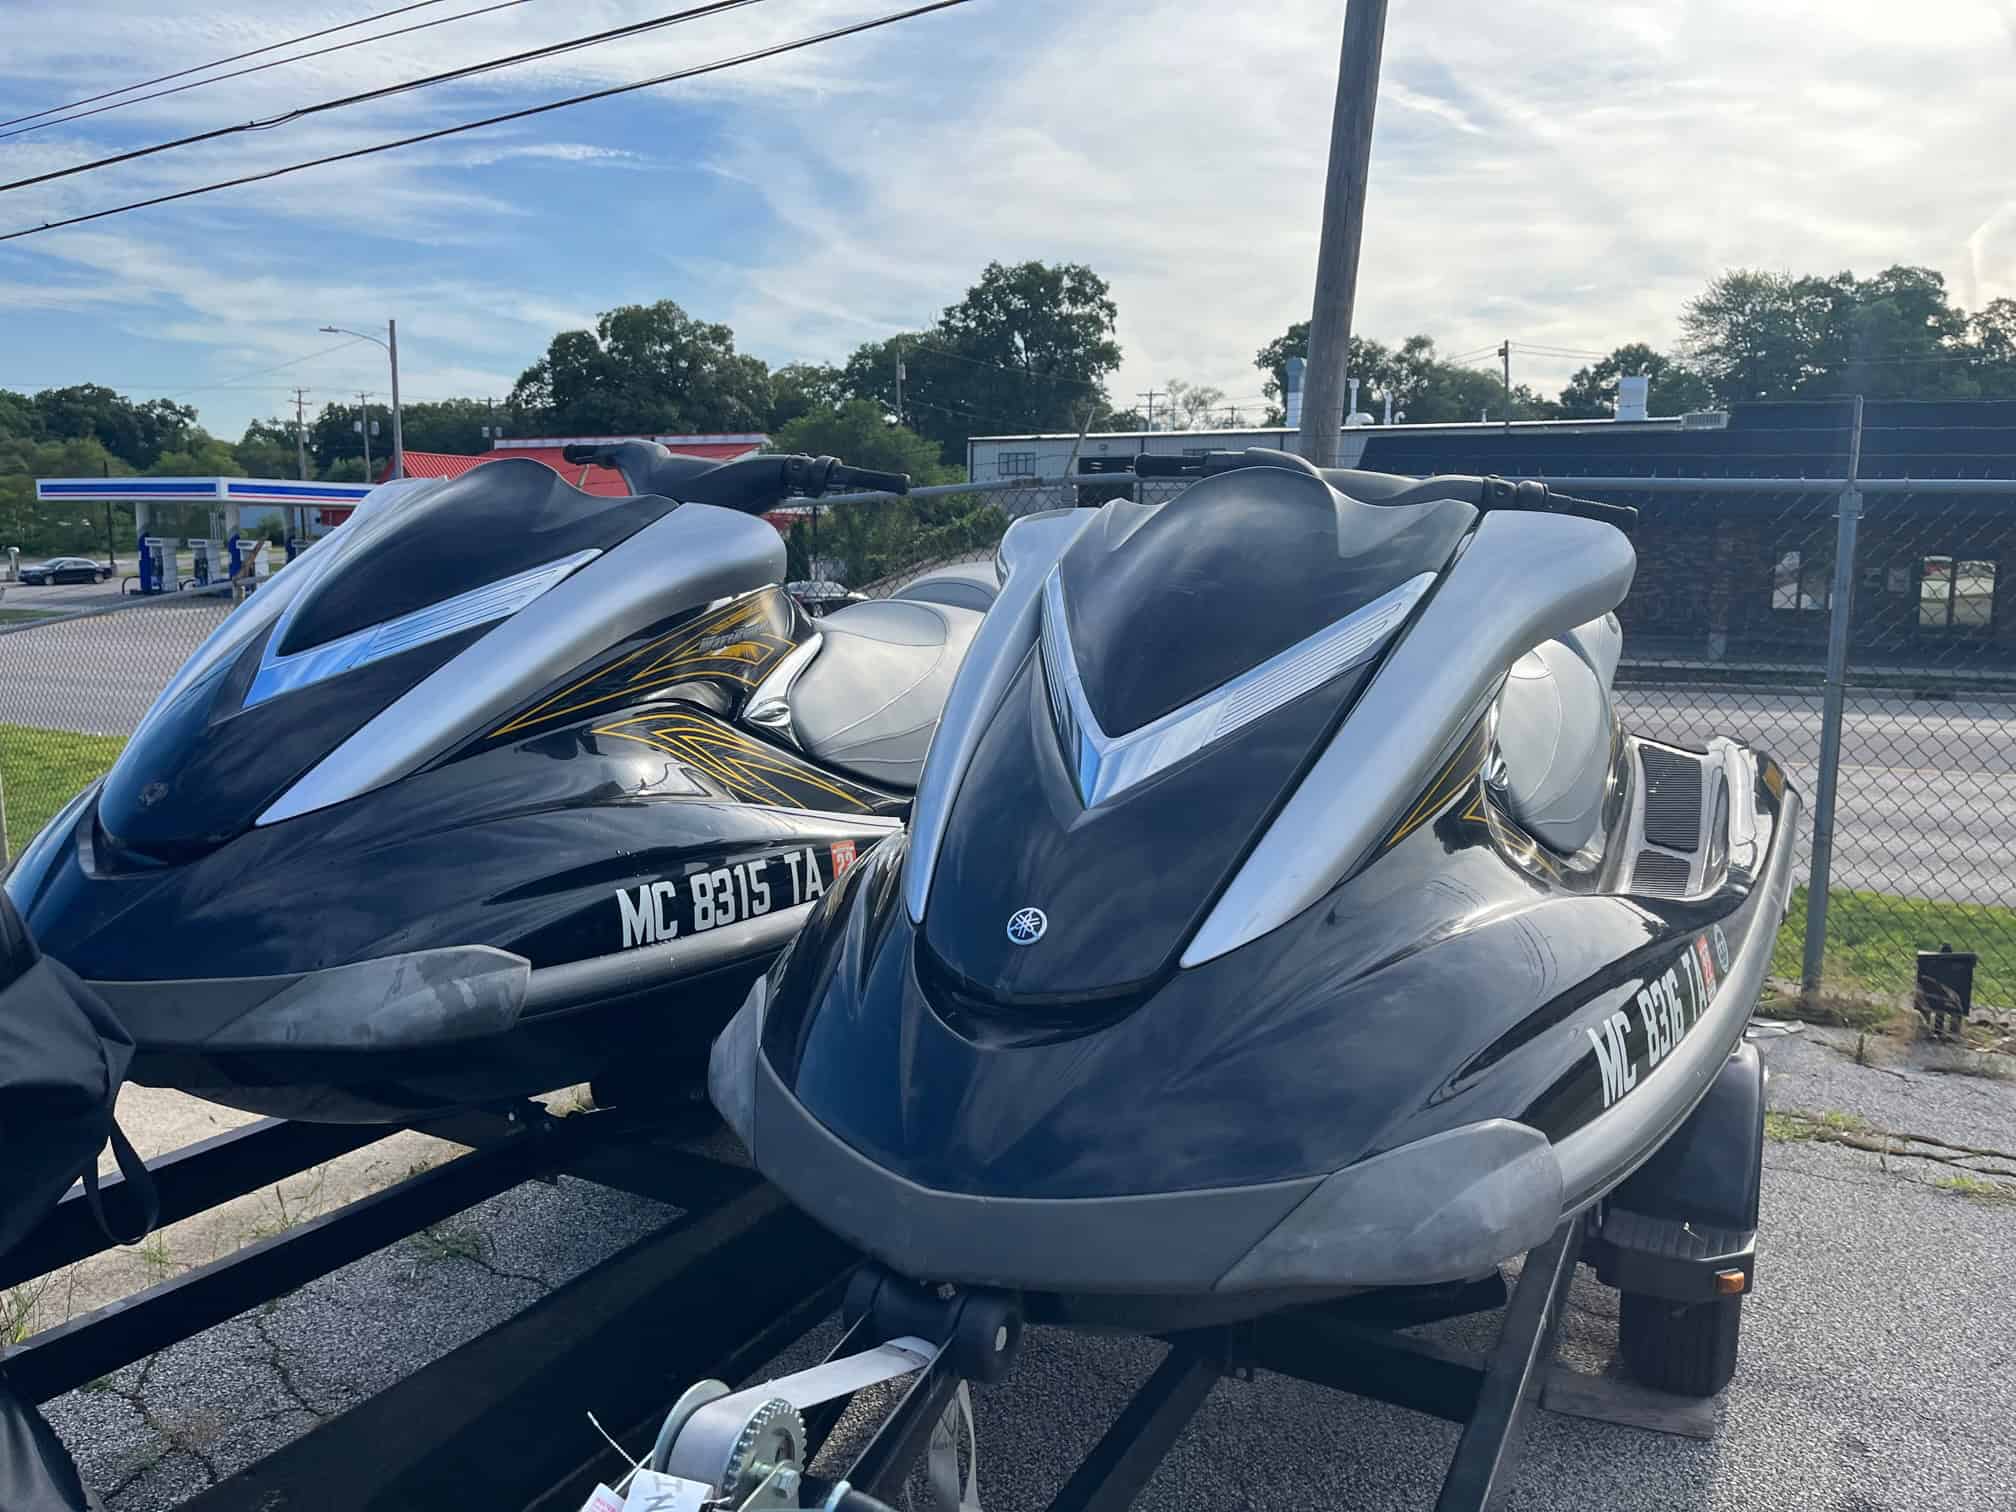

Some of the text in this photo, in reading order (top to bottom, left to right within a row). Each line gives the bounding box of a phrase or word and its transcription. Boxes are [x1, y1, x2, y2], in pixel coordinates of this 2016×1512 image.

[616, 847, 825, 948] MC 8315 TA
[1587, 1011, 1637, 1108] MC
[1637, 968, 1685, 1067] 8316
[1681, 944, 1708, 1022] TA
